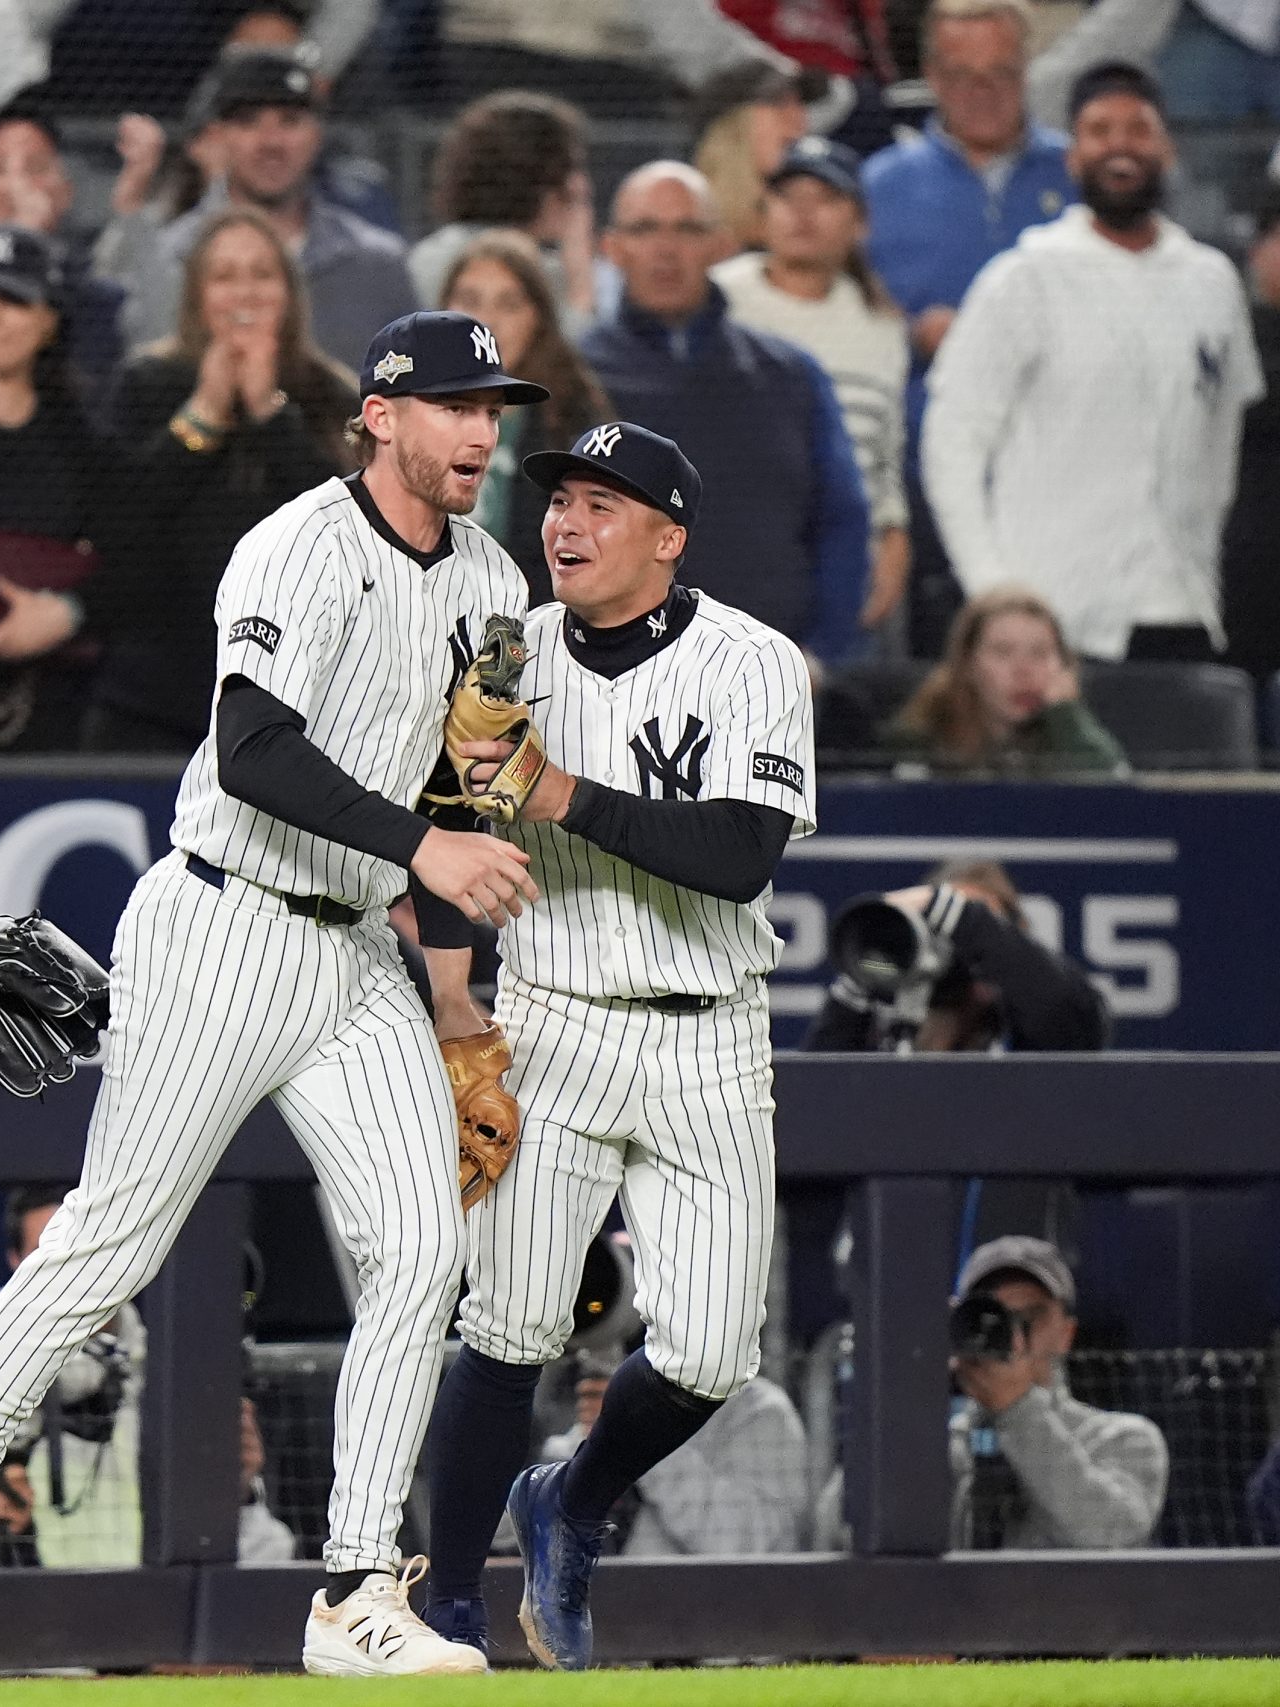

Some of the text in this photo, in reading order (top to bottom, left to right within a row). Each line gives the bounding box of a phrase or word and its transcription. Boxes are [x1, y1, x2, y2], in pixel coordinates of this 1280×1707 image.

[469, 325, 500, 365] NY
[582, 424, 623, 458] NY
[228, 620, 278, 649] STARR
[646, 609, 668, 639] NY
[628, 713, 711, 801] NY
[753, 757, 803, 790] STARR
